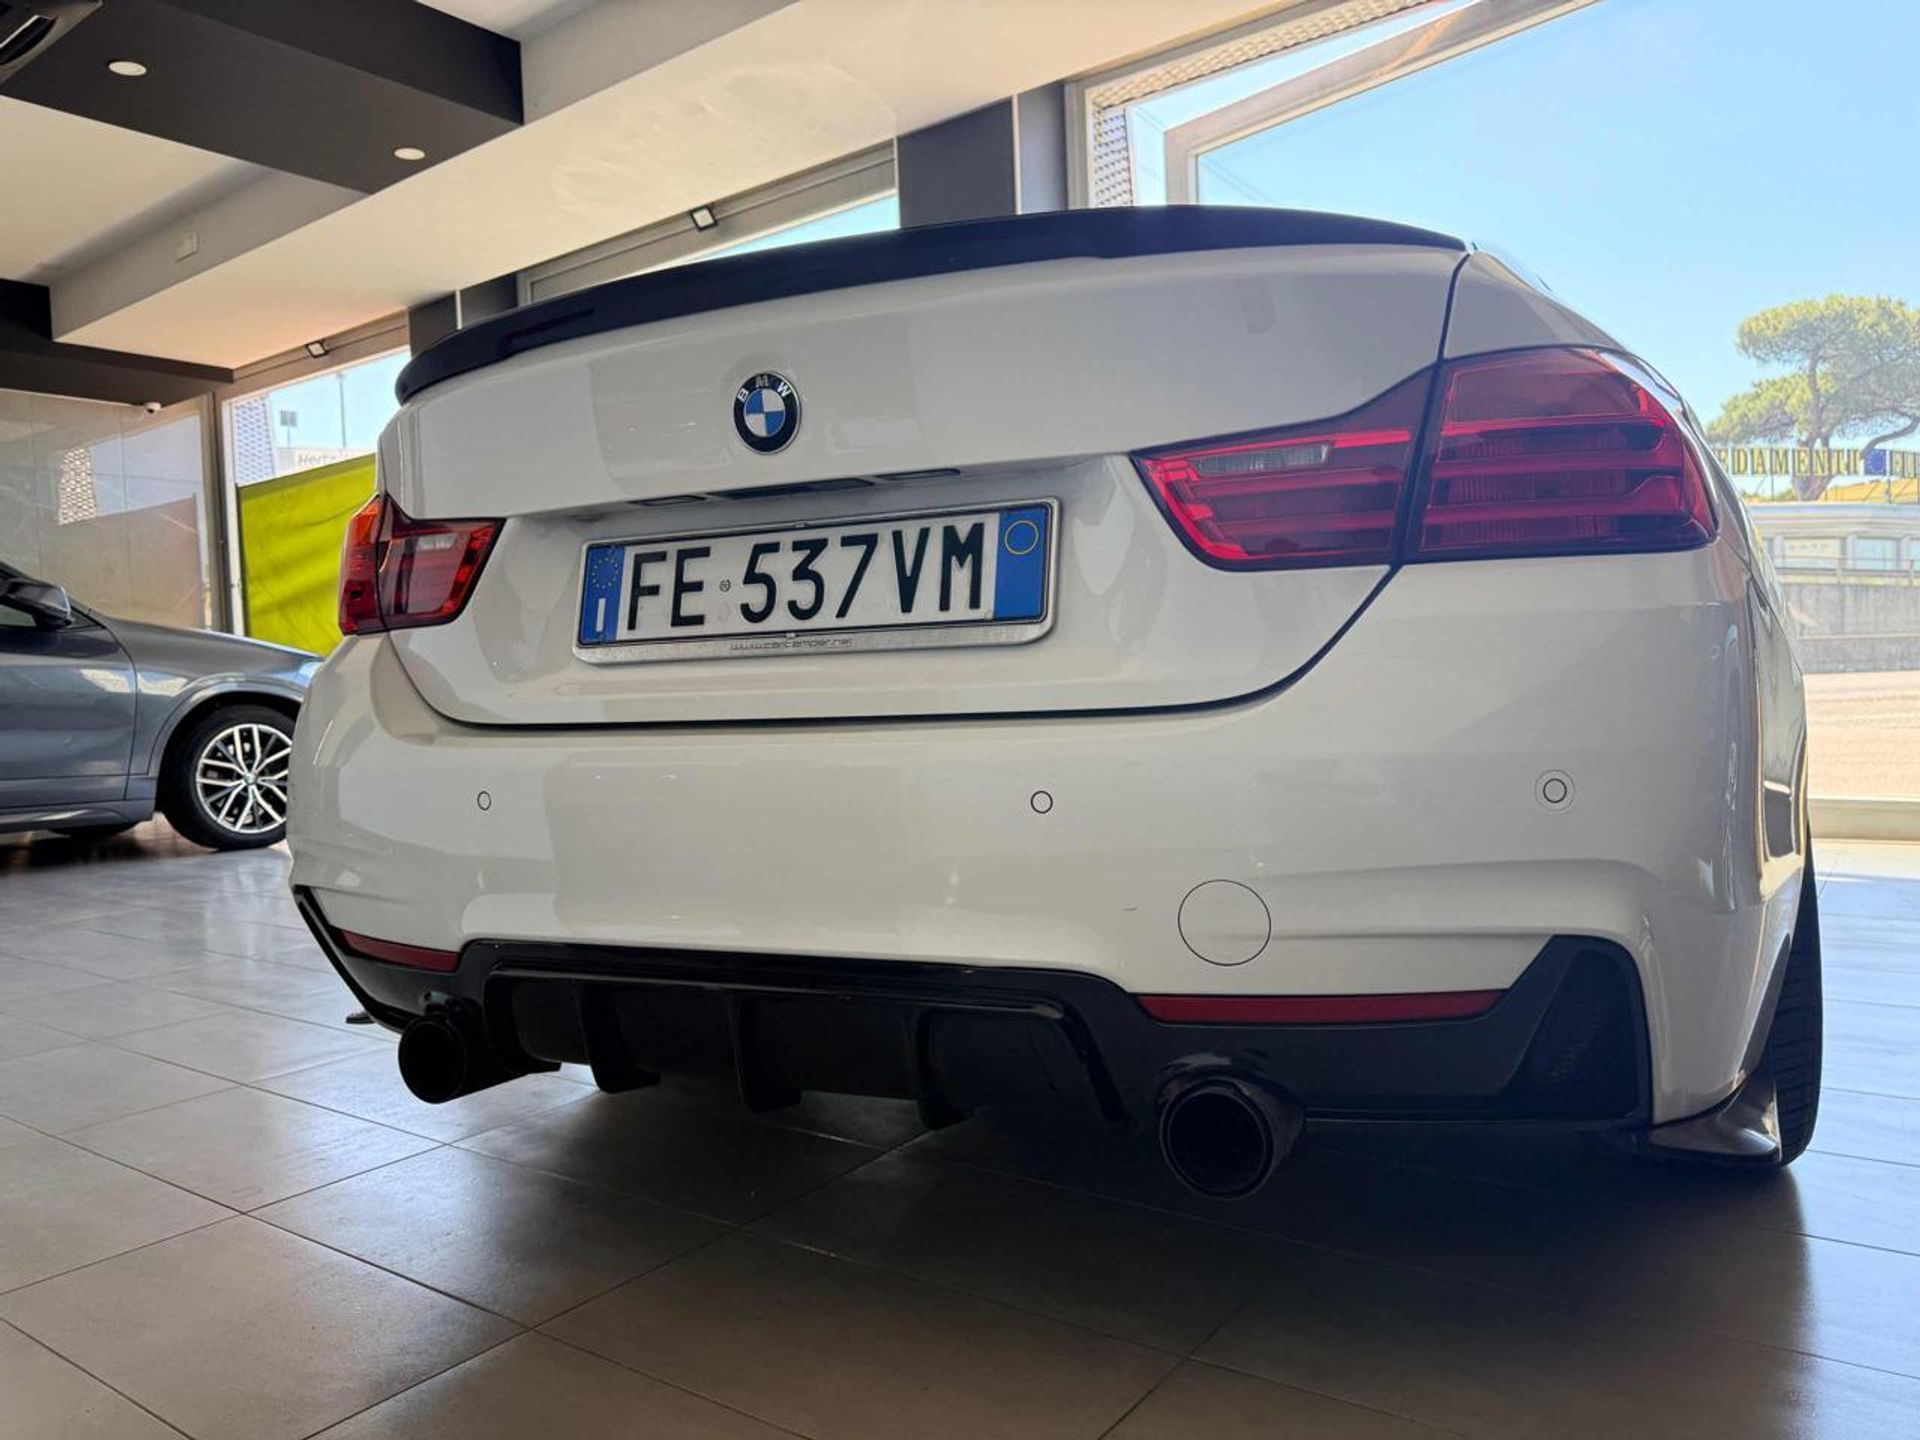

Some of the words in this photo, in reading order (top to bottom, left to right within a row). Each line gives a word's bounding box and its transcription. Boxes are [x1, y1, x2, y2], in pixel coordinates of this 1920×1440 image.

[736, 374, 792, 403] BMW
[627, 546, 711, 631] FE
[739, 522, 985, 624] 537VM
